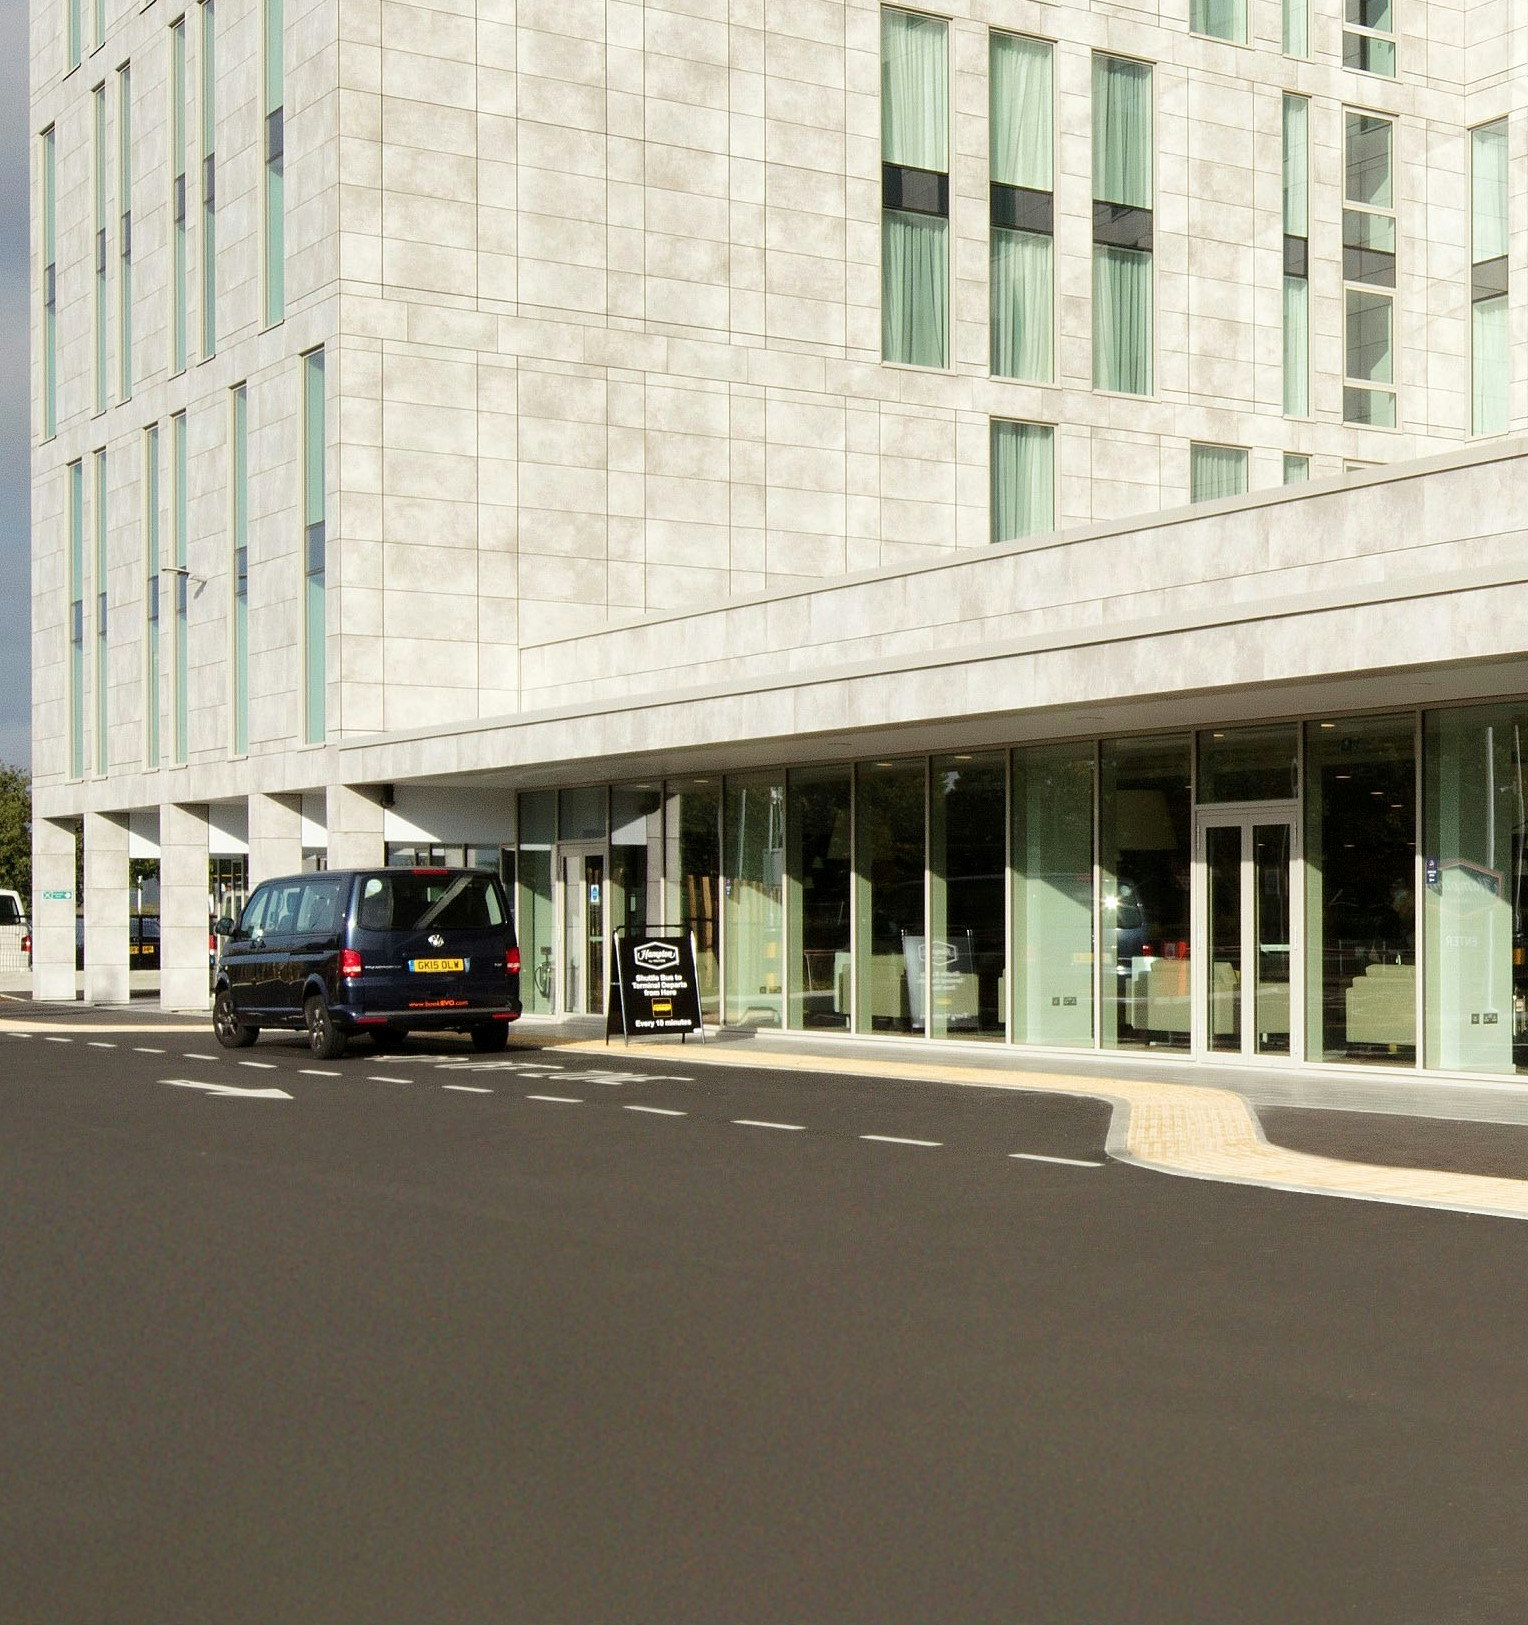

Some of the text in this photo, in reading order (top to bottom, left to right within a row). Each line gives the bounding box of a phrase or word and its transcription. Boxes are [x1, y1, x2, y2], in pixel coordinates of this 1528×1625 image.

[637, 949, 676, 960] Hampton
[417, 960, 440, 970] GK15
[632, 981, 660, 989] Terminal
[635, 1019, 655, 1028] Every
